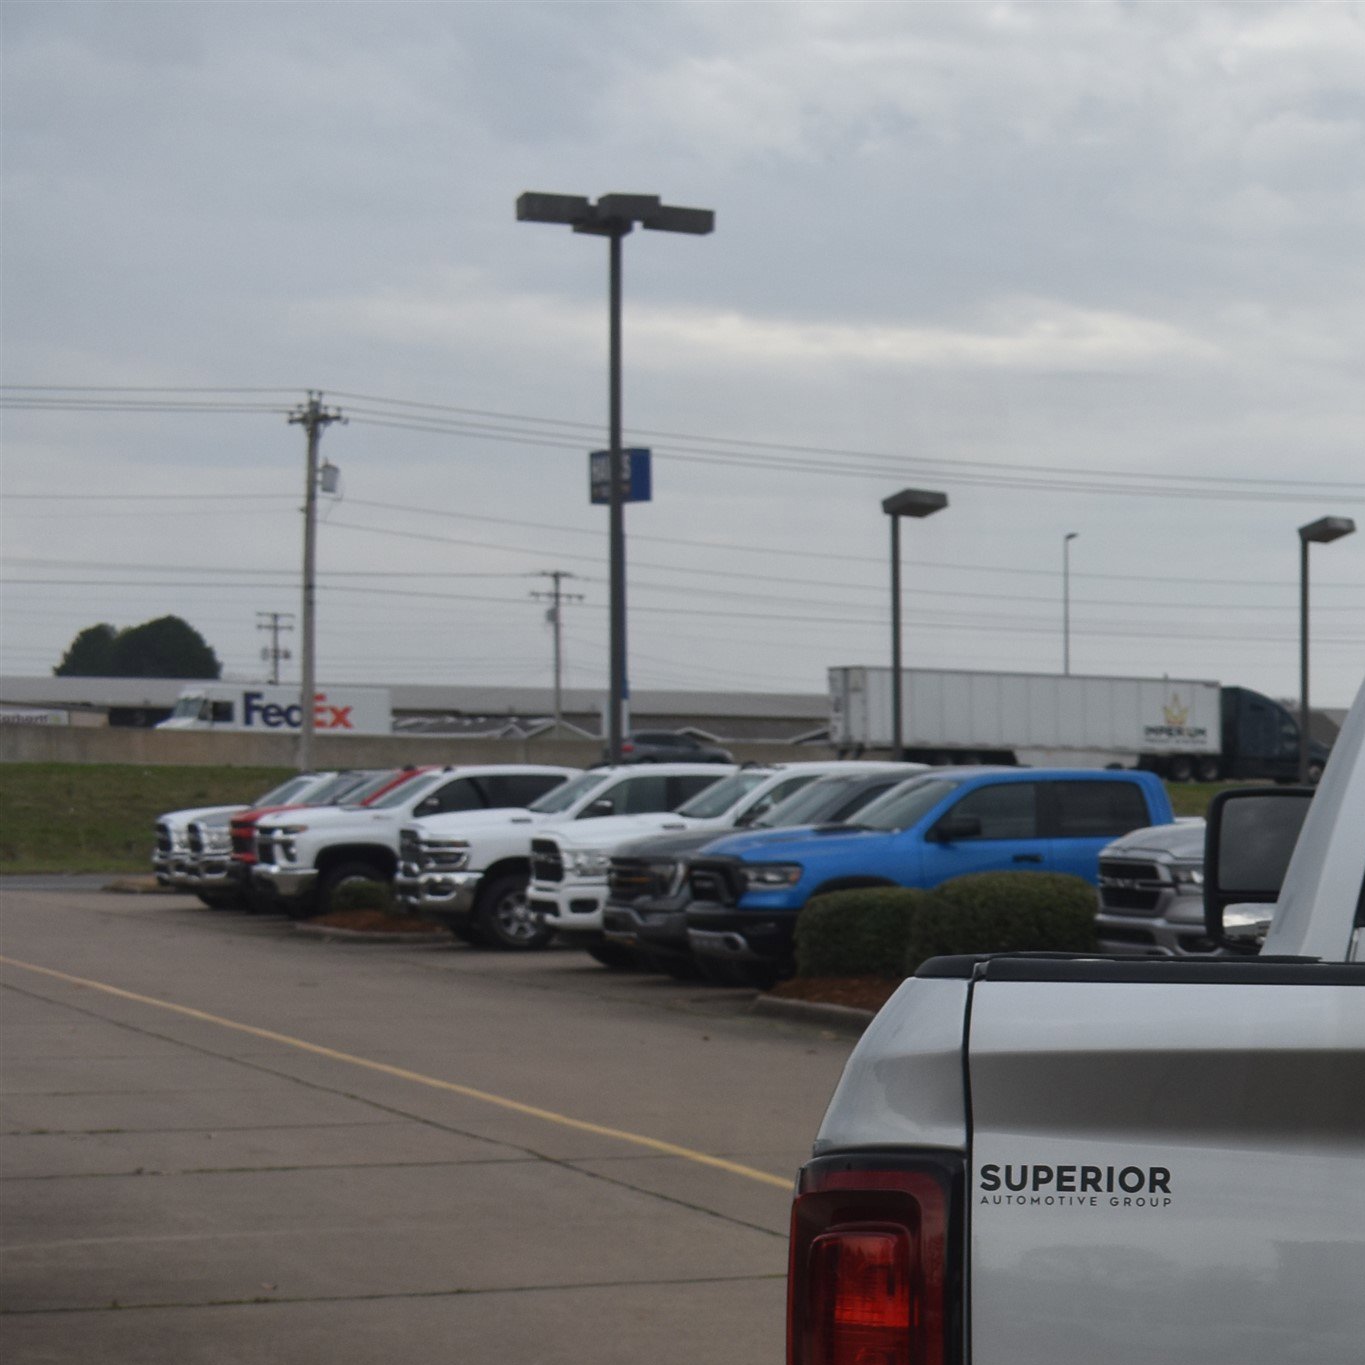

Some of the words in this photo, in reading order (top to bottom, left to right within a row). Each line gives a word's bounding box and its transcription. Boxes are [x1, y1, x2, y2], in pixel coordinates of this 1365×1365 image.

[980, 1164, 1172, 1194] SUPERIOR
[980, 1195, 1098, 1207] AUTOMOTIVE
[1109, 1196, 1172, 1208] GROUP
